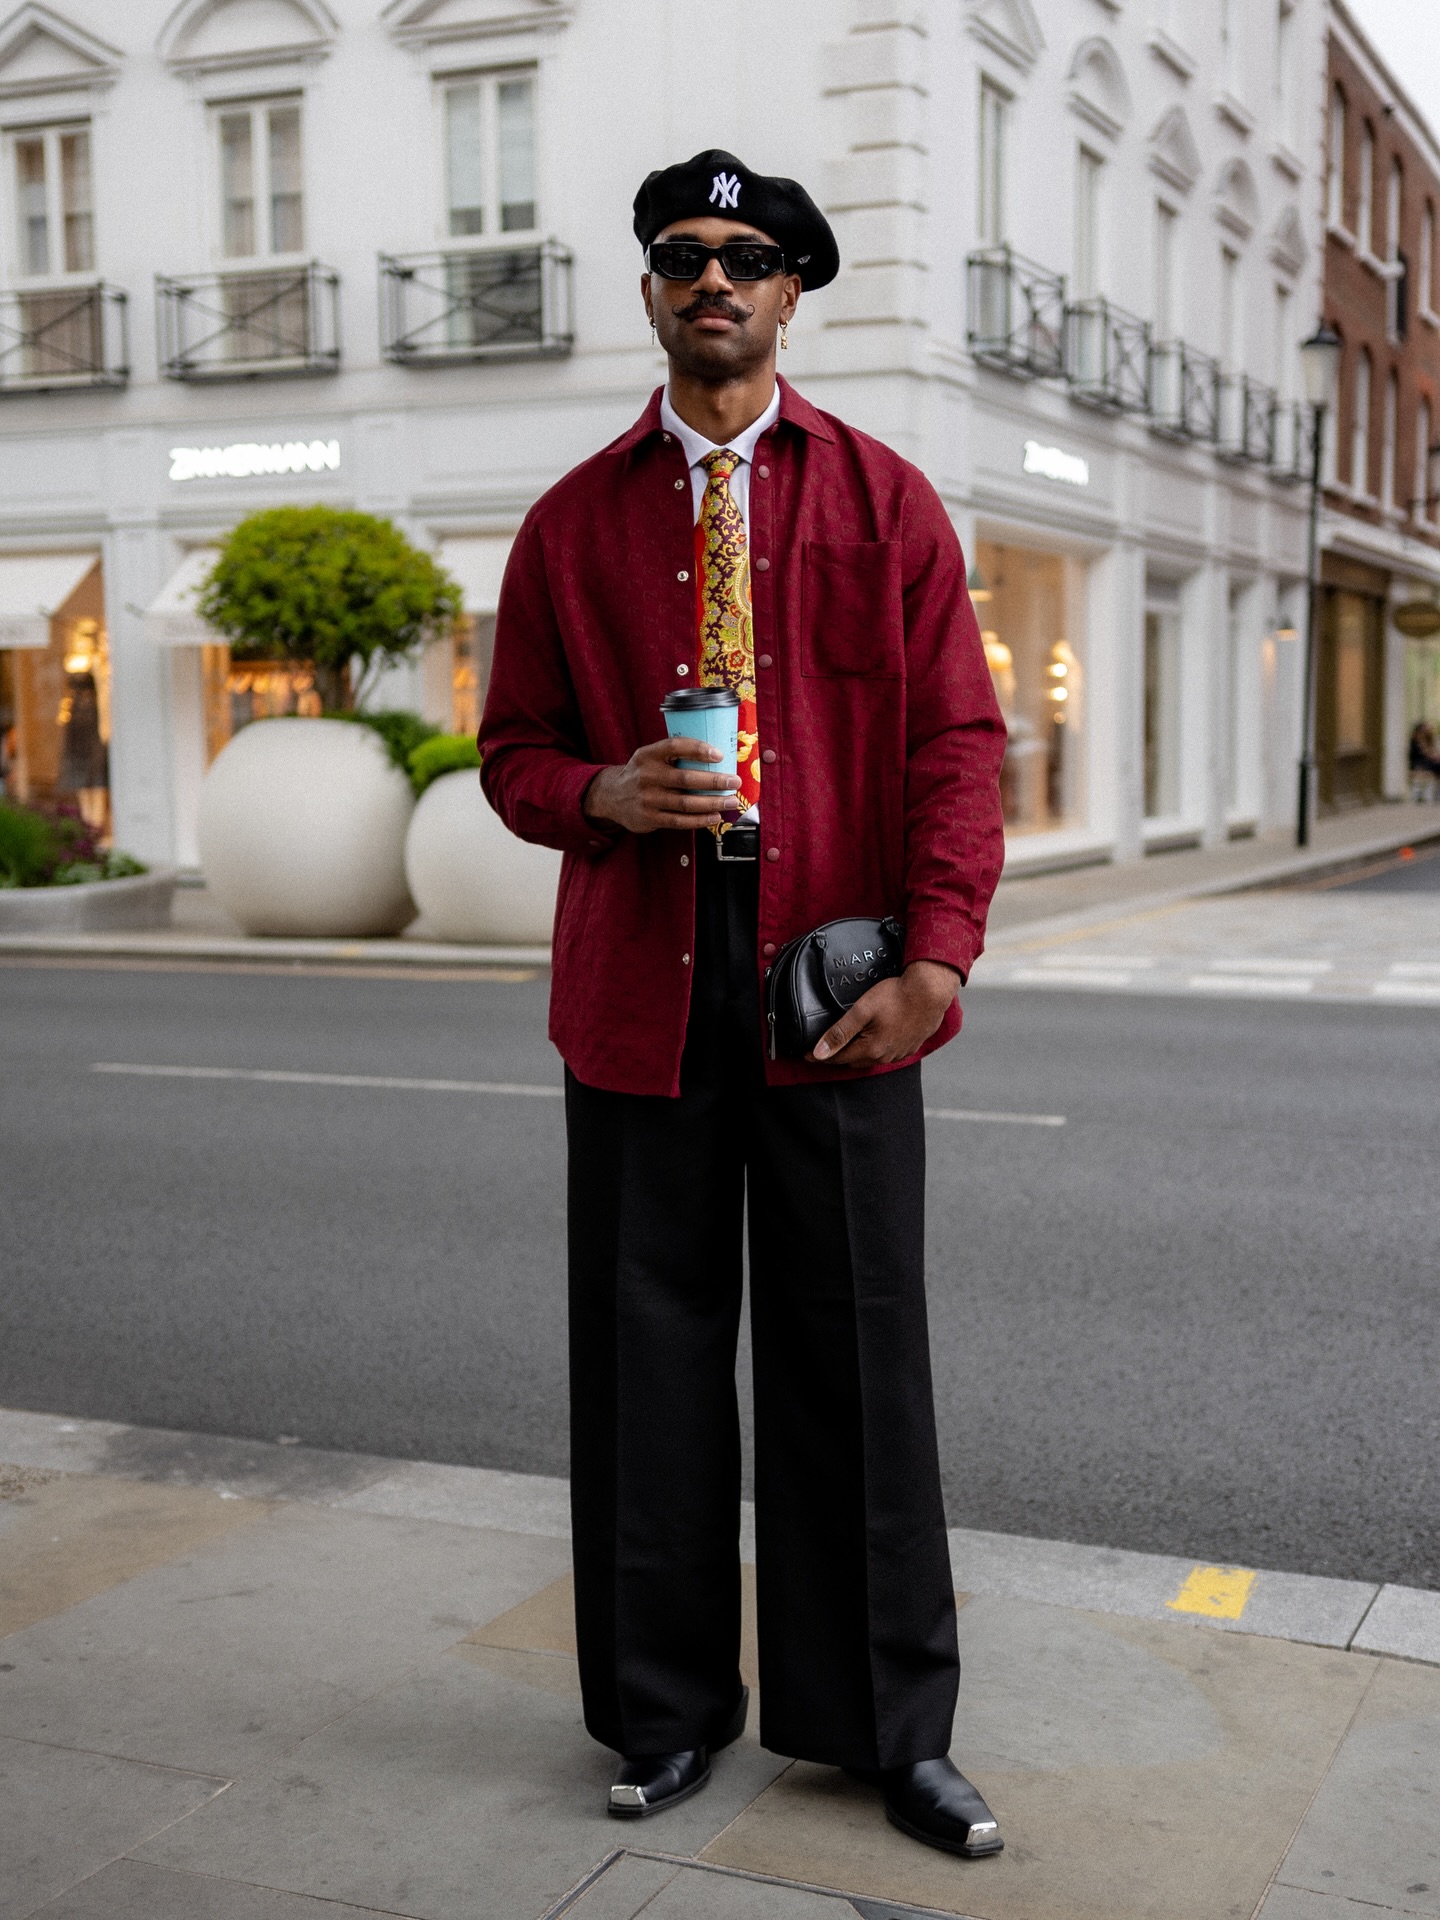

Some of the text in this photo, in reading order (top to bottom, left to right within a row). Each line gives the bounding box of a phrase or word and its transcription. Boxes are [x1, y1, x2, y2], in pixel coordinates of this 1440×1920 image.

[709, 172, 741, 208] NY
[833, 947, 887, 968] MARC
[829, 966, 892, 988] JACO
